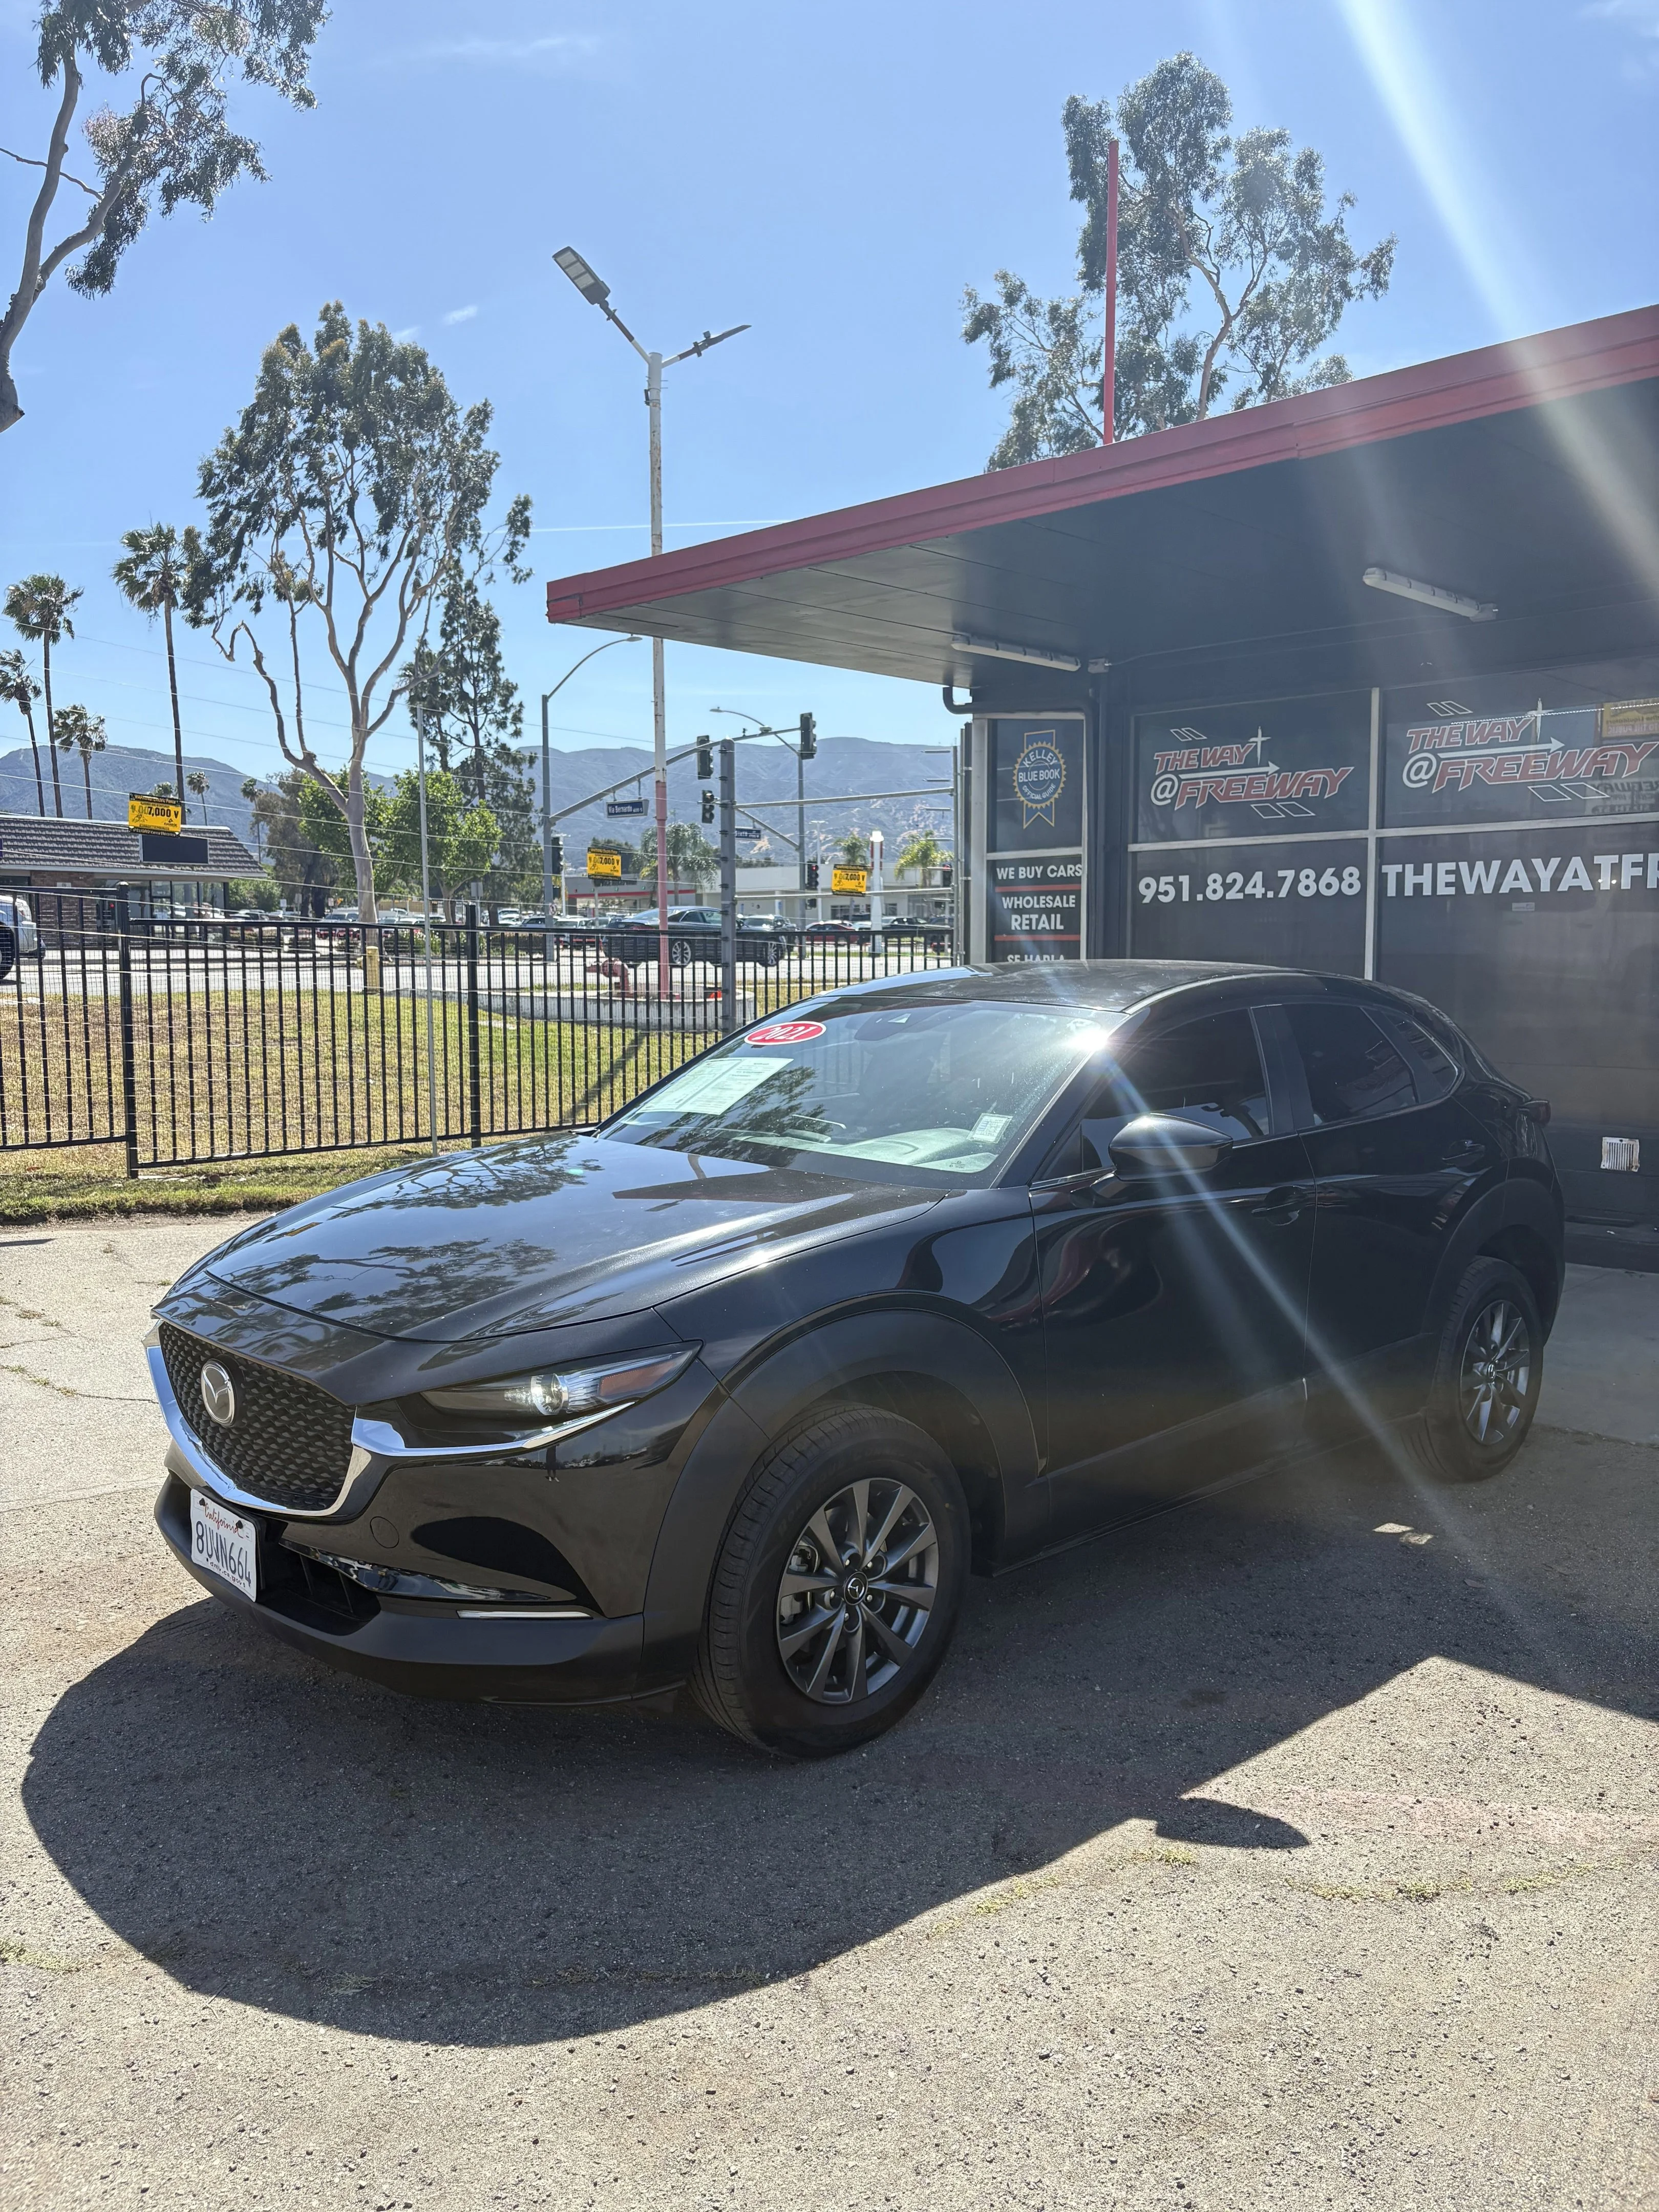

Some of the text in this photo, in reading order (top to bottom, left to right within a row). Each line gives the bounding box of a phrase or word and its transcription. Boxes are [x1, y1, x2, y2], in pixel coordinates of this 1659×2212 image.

[1407, 717, 1535, 754] THE WAY
[1023, 750, 1058, 768] KELLEY
[1154, 743, 1256, 775] THE WAY
[1402, 741, 1659, 794] @FREEWAY
[1018, 769, 1060, 782] BLUE BOOK
[1023, 782, 1056, 800] OFFICIAL GUIDE
[1151, 767, 1355, 811] @FREEWAY
[148, 806, 179, 819] 7,000 V
[996, 864, 1082, 880] WE BUY CARS
[1139, 866, 1362, 904] 951.824.7868
[1002, 895, 1075, 909] WHOLESALE
[1011, 914, 1064, 930] RETAIL
[751, 1026, 819, 1040] 2021
[205, 1502, 244, 1539] California
[196, 1521, 251, 1587] 8UVN664
